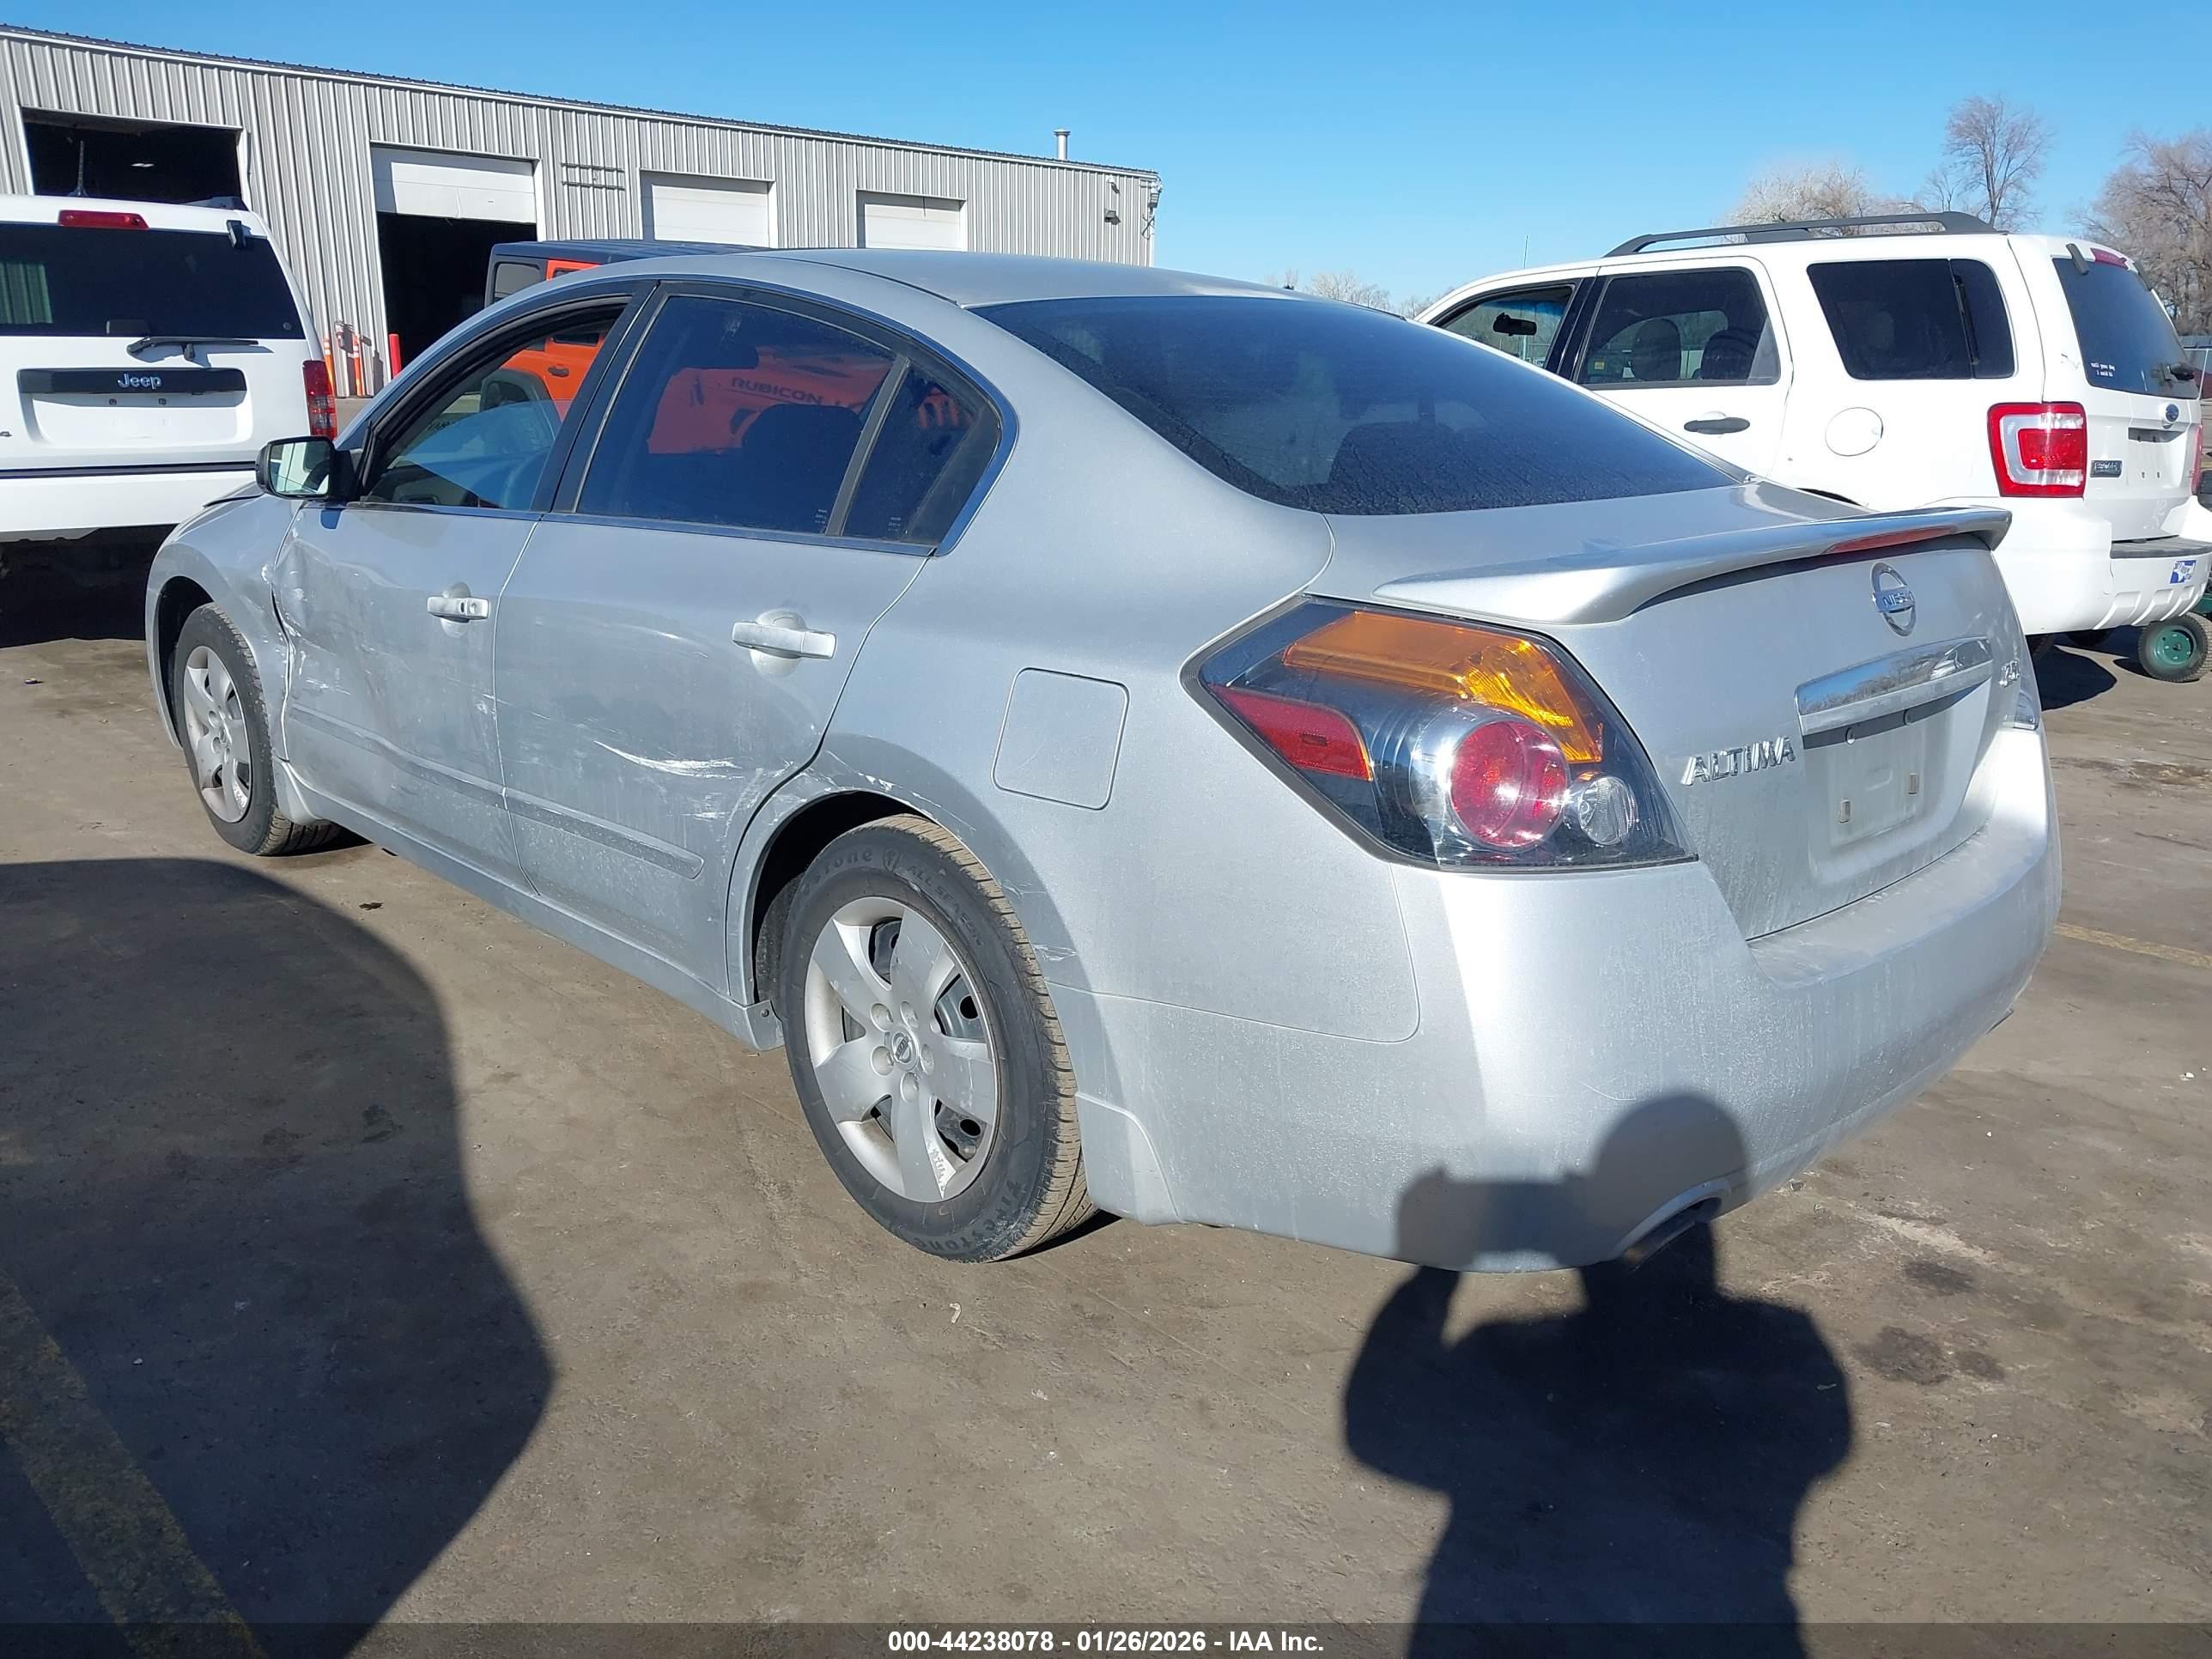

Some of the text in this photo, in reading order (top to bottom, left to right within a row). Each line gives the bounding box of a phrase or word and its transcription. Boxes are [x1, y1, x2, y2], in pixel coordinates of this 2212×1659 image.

[117, 373, 161, 390] Jeep
[732, 377, 824, 404] RUBICON
[1680, 737, 1796, 786] ALTIMA
